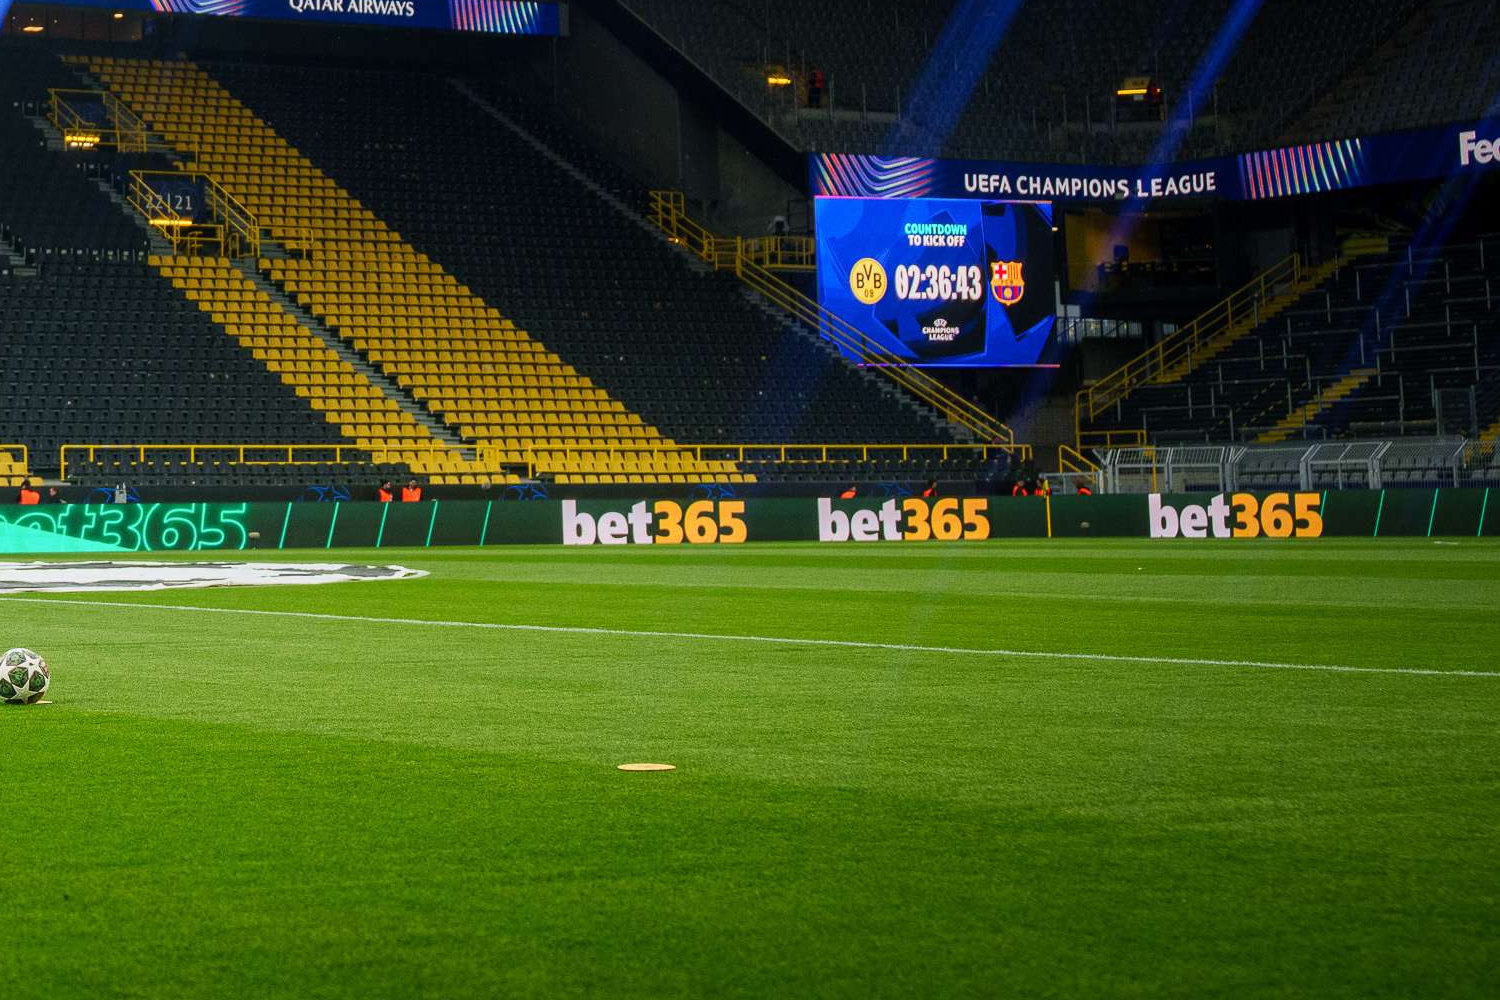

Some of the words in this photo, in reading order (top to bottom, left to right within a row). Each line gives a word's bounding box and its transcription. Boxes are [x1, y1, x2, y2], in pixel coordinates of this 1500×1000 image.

[964, 173, 1011, 195] UEFA
[1016, 176, 1130, 198] CHAMPIONS
[1136, 171, 1216, 198] LEAGUE
[904, 223, 967, 236] COUNTDOWN
[908, 234, 921, 246] TO
[923, 234, 946, 247] KICK
[947, 235, 965, 247] OFF
[856, 264, 882, 289] BVB
[895, 264, 982, 301] 02:36:43
[922, 326, 960, 335] CHAMPIONS
[929, 333, 954, 341] LEAGUE
[561, 499, 747, 545] bet365
[818, 497, 991, 542] bet365
[1148, 492, 1323, 538] bet365
